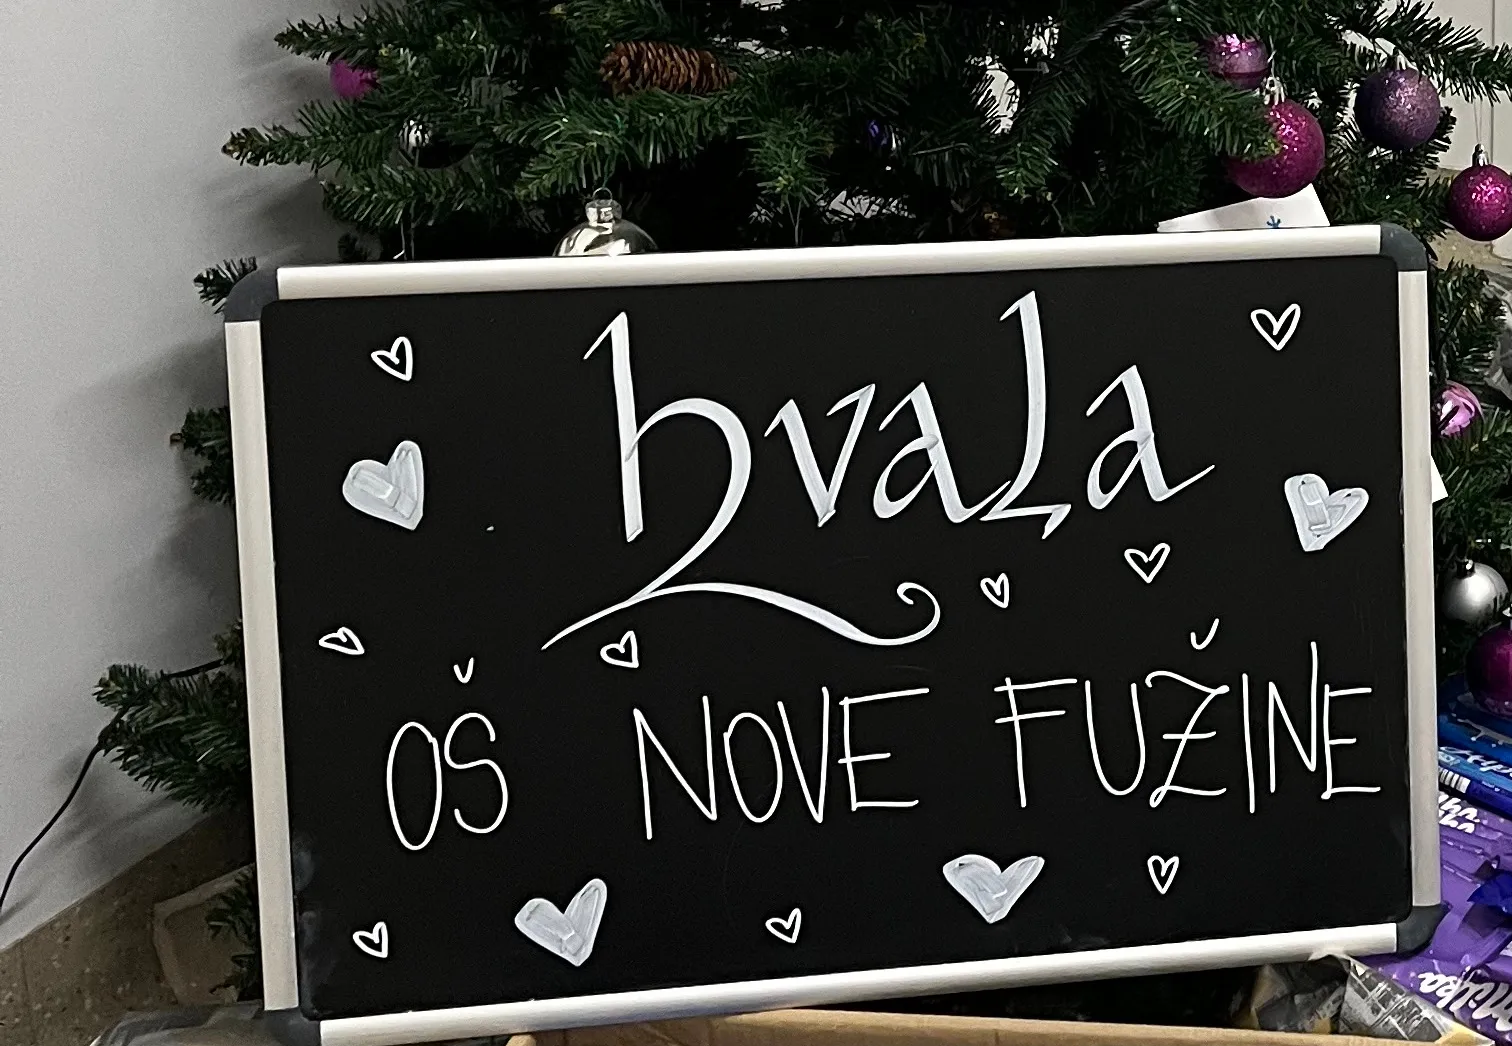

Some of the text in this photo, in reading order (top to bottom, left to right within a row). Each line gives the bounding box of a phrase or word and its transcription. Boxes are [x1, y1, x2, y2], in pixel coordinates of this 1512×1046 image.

[386, 619, 1382, 851] OŠ NOVE FUŽINE
